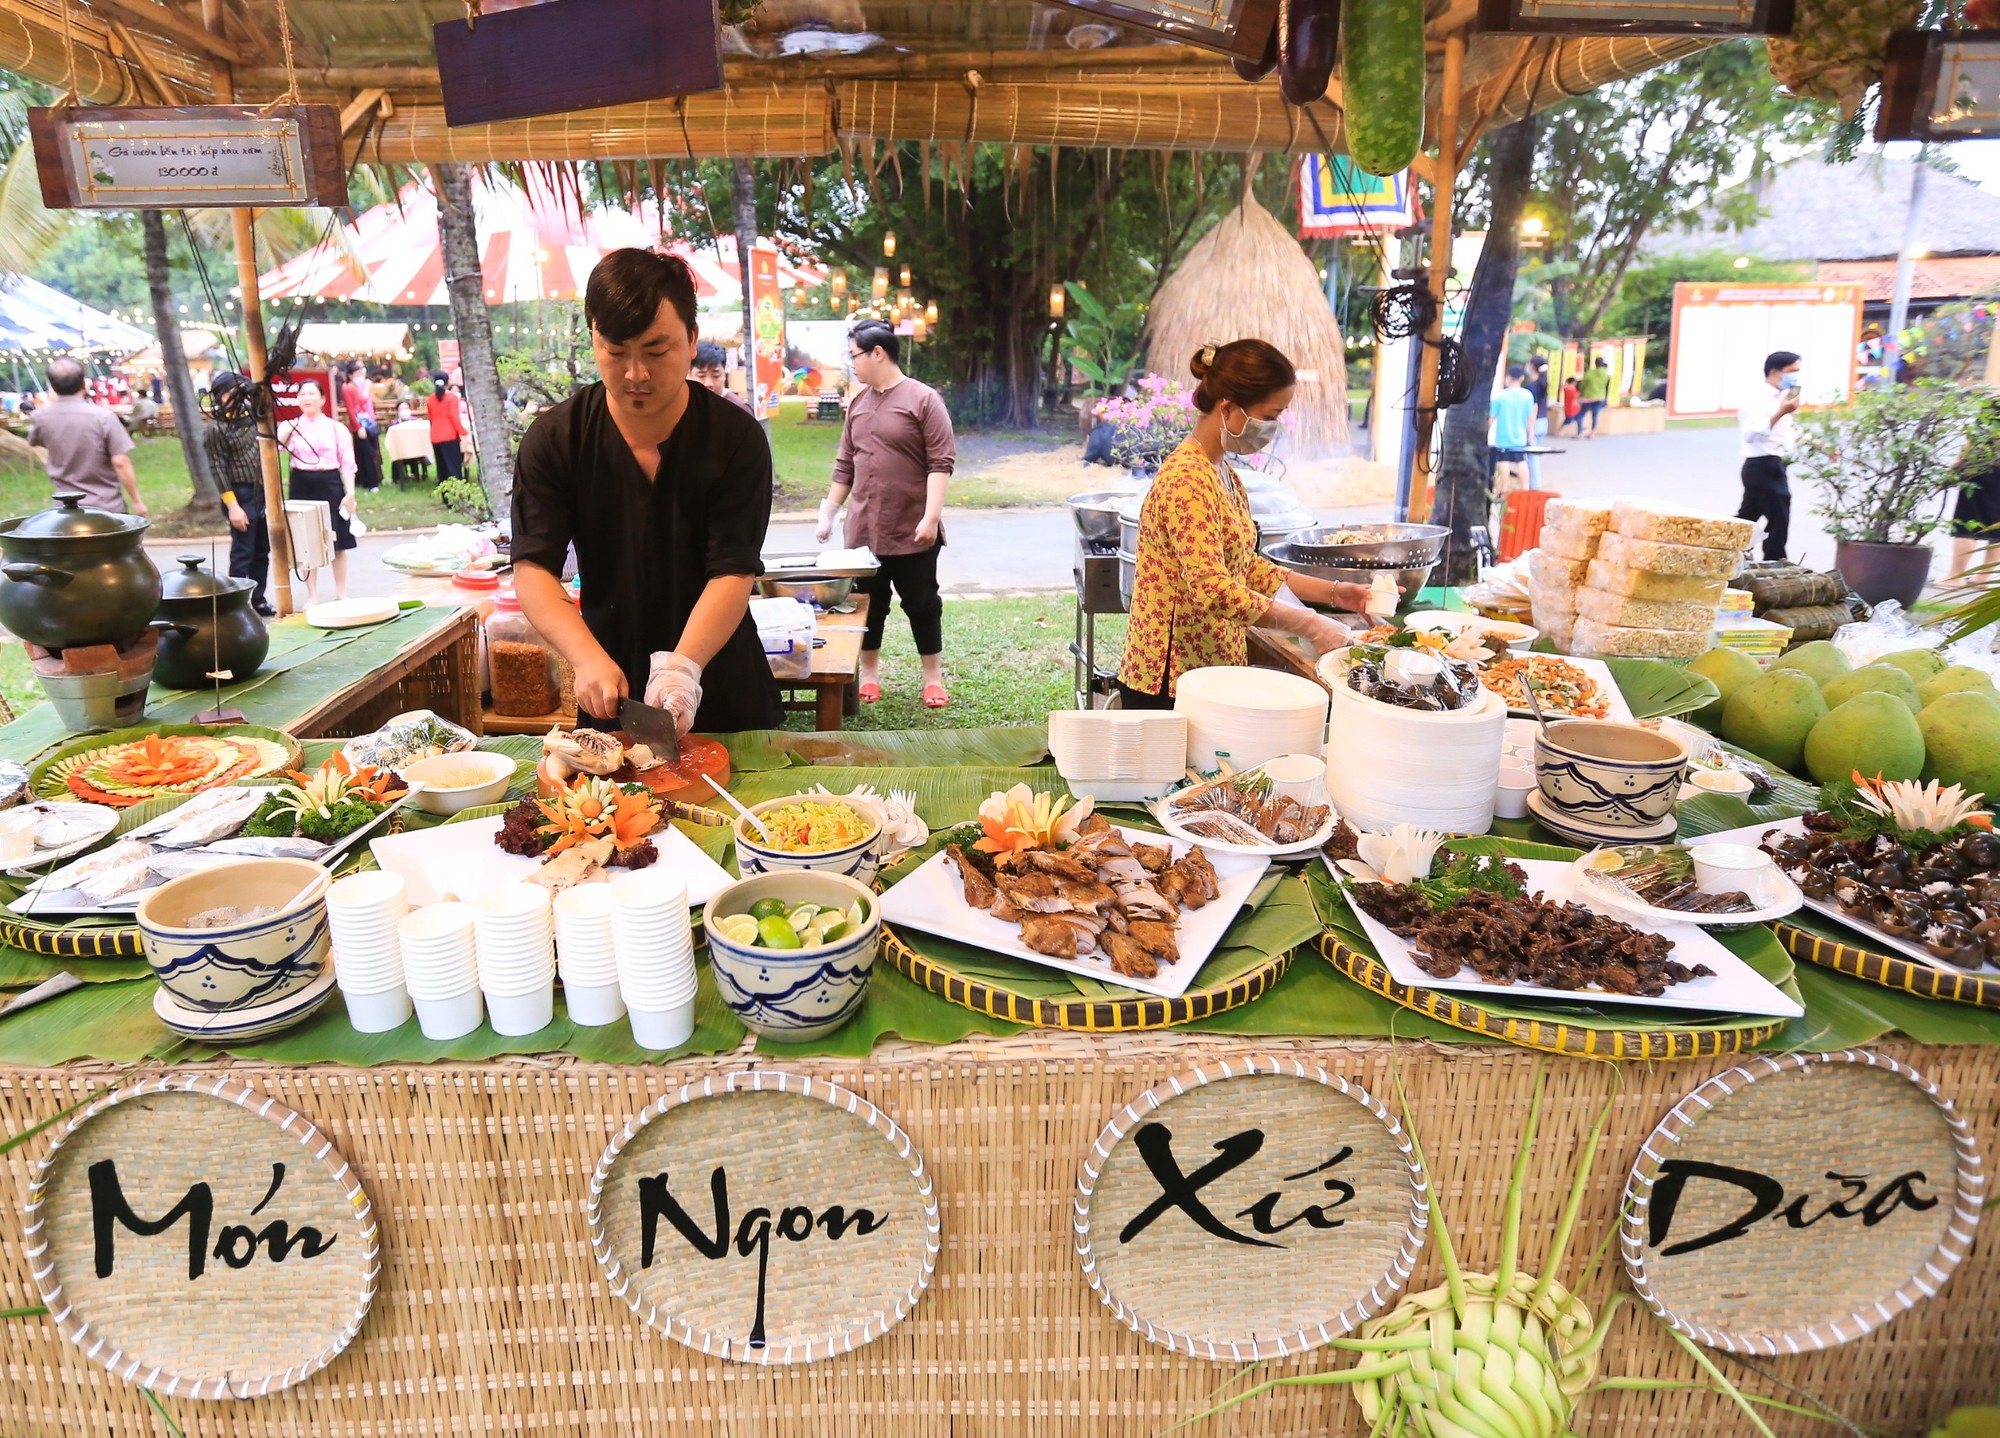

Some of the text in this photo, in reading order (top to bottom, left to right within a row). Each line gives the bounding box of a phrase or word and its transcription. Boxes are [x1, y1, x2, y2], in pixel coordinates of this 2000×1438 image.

[88, 1121, 1940, 1349] Món Ngon Xứ Dừa
